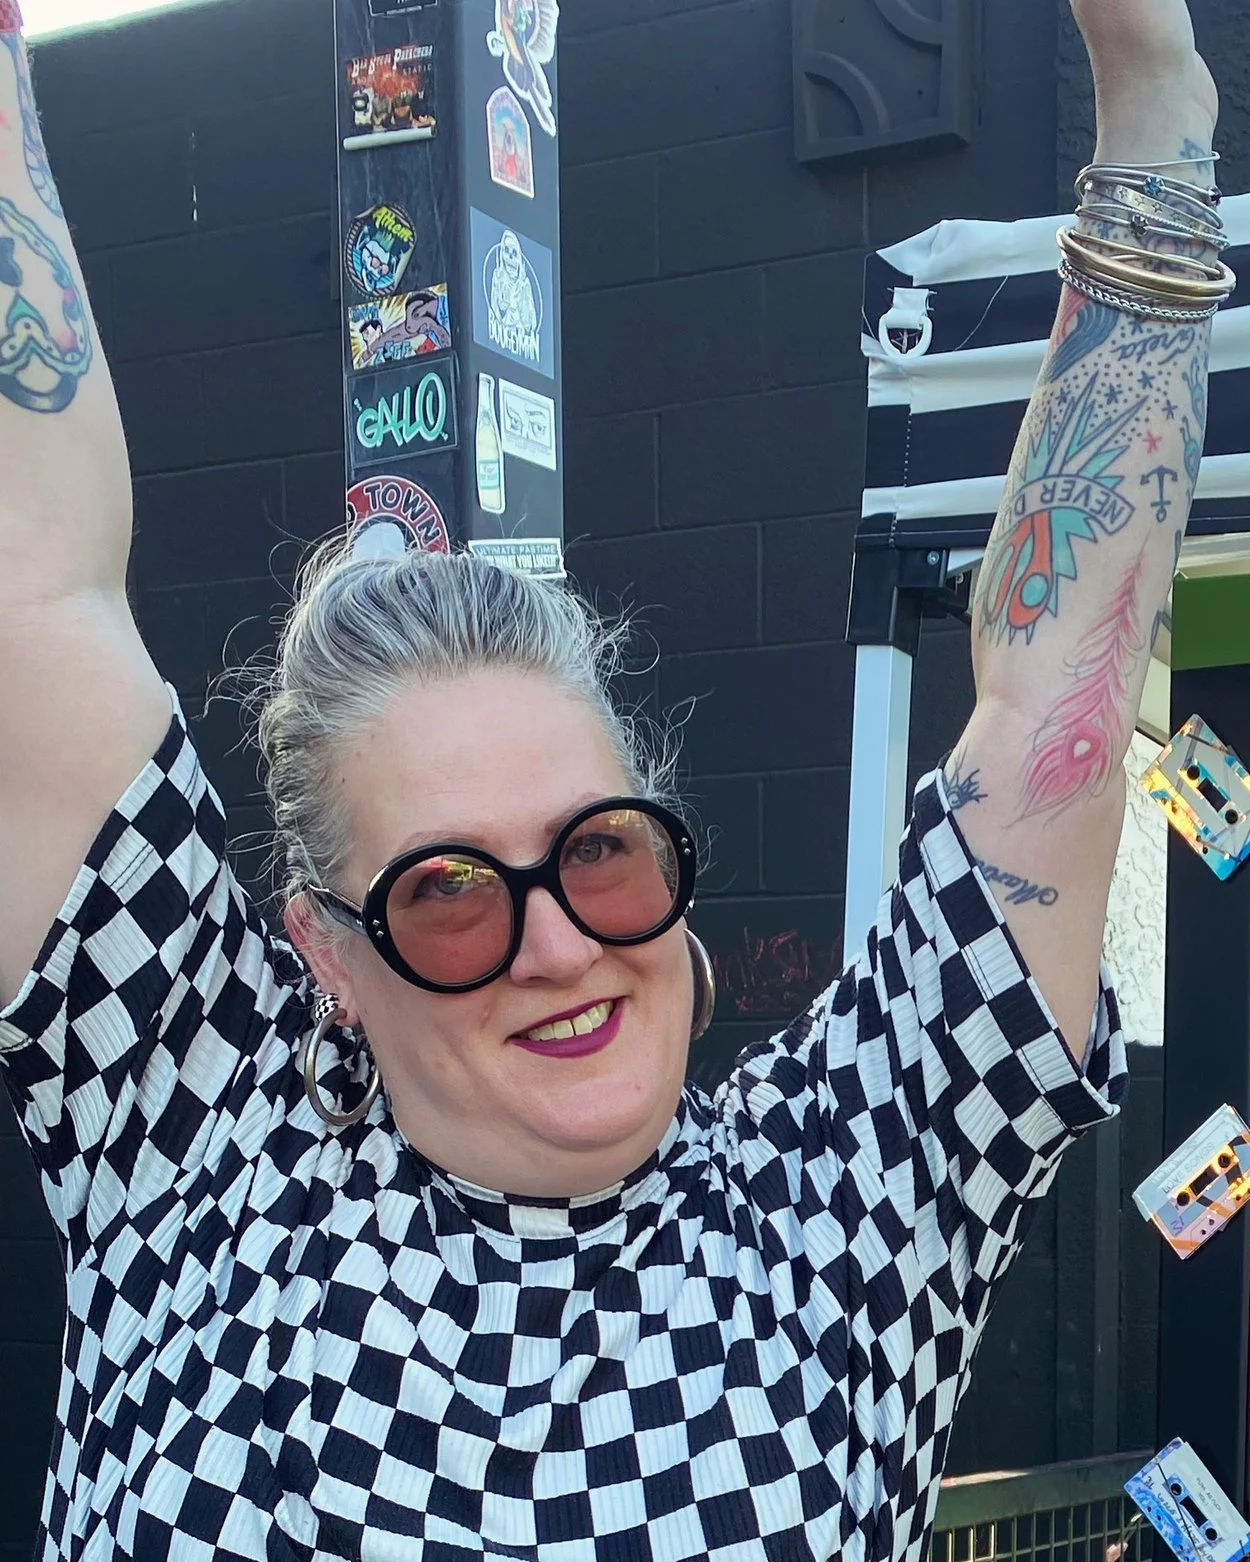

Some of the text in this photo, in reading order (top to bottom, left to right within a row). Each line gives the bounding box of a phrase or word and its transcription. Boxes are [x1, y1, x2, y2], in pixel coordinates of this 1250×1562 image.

[1115, 326, 1196, 364] Greta
[365, 482, 440, 544] TOWN
[1040, 482, 1125, 524] NEVER
